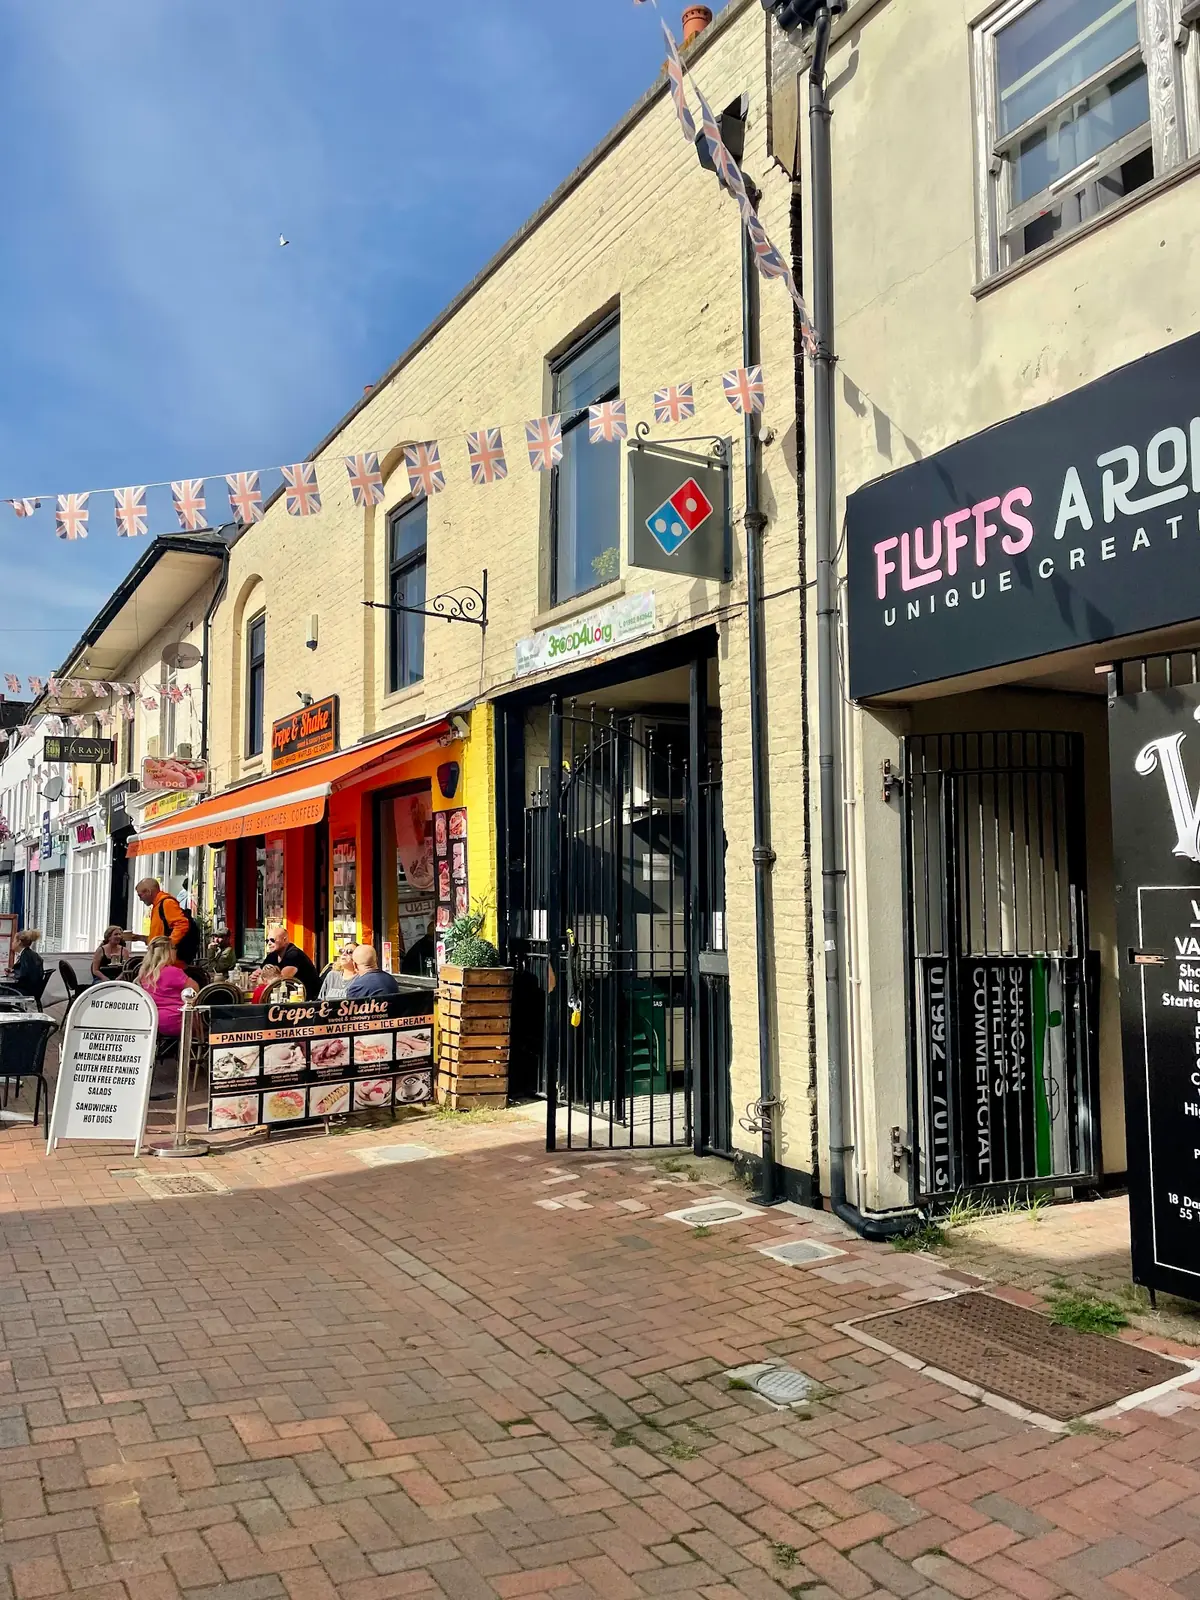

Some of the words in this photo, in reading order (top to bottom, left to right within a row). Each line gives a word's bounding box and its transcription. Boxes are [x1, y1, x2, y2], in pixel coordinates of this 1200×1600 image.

[873, 486, 1034, 600] FLUFFS
[884, 570, 1012, 627] UNIQUE
[1038, 508, 1200, 579] CREAT
[300, 708, 328, 737] Shake
[291, 805, 319, 823] COFFEES
[91, 1000, 104, 1008] HOT
[104, 1001, 140, 1011] CHOCOLATE
[268, 1005, 315, 1025] Crepe
[318, 1001, 332, 1017] &
[337, 998, 388, 1016] Shake
[221, 1031, 263, 1042] PANINIS
[275, 1027, 315, 1038] SHAKES
[326, 1022, 370, 1033] WAFFLES
[381, 1020, 395, 1028] ICE
[397, 1016, 425, 1027] CREAM
[992, 967, 1009, 1097] PHILLIPS
[83, 1032, 105, 1040] JACKET
[105, 1034, 136, 1042] POTATOES
[89, 1042, 123, 1052] OMELETTES
[73, 1052, 106, 1061] AMERICAN
[107, 1054, 141, 1063] BREAKFAST
[75, 1063, 99, 1072] GLUTEN
[99, 1065, 114, 1073] FREE
[115, 1066, 140, 1075] PANINIS
[973, 967, 991, 1175] COMMERCIAL
[73, 1074, 97, 1083] GLUTEN
[97, 1075, 111, 1083] FREE
[112, 1076, 136, 1085] CREPES
[88, 1087, 112, 1095] SALADS
[76, 1102, 117, 1112] SANDWICHES
[1184, 1102, 1200, 1118] Hi
[83, 1114, 96, 1122] HOT
[96, 1115, 112, 1123] DOGS
[1168, 1192, 1179, 1204] 18
[1179, 1207, 1193, 1219] 55
